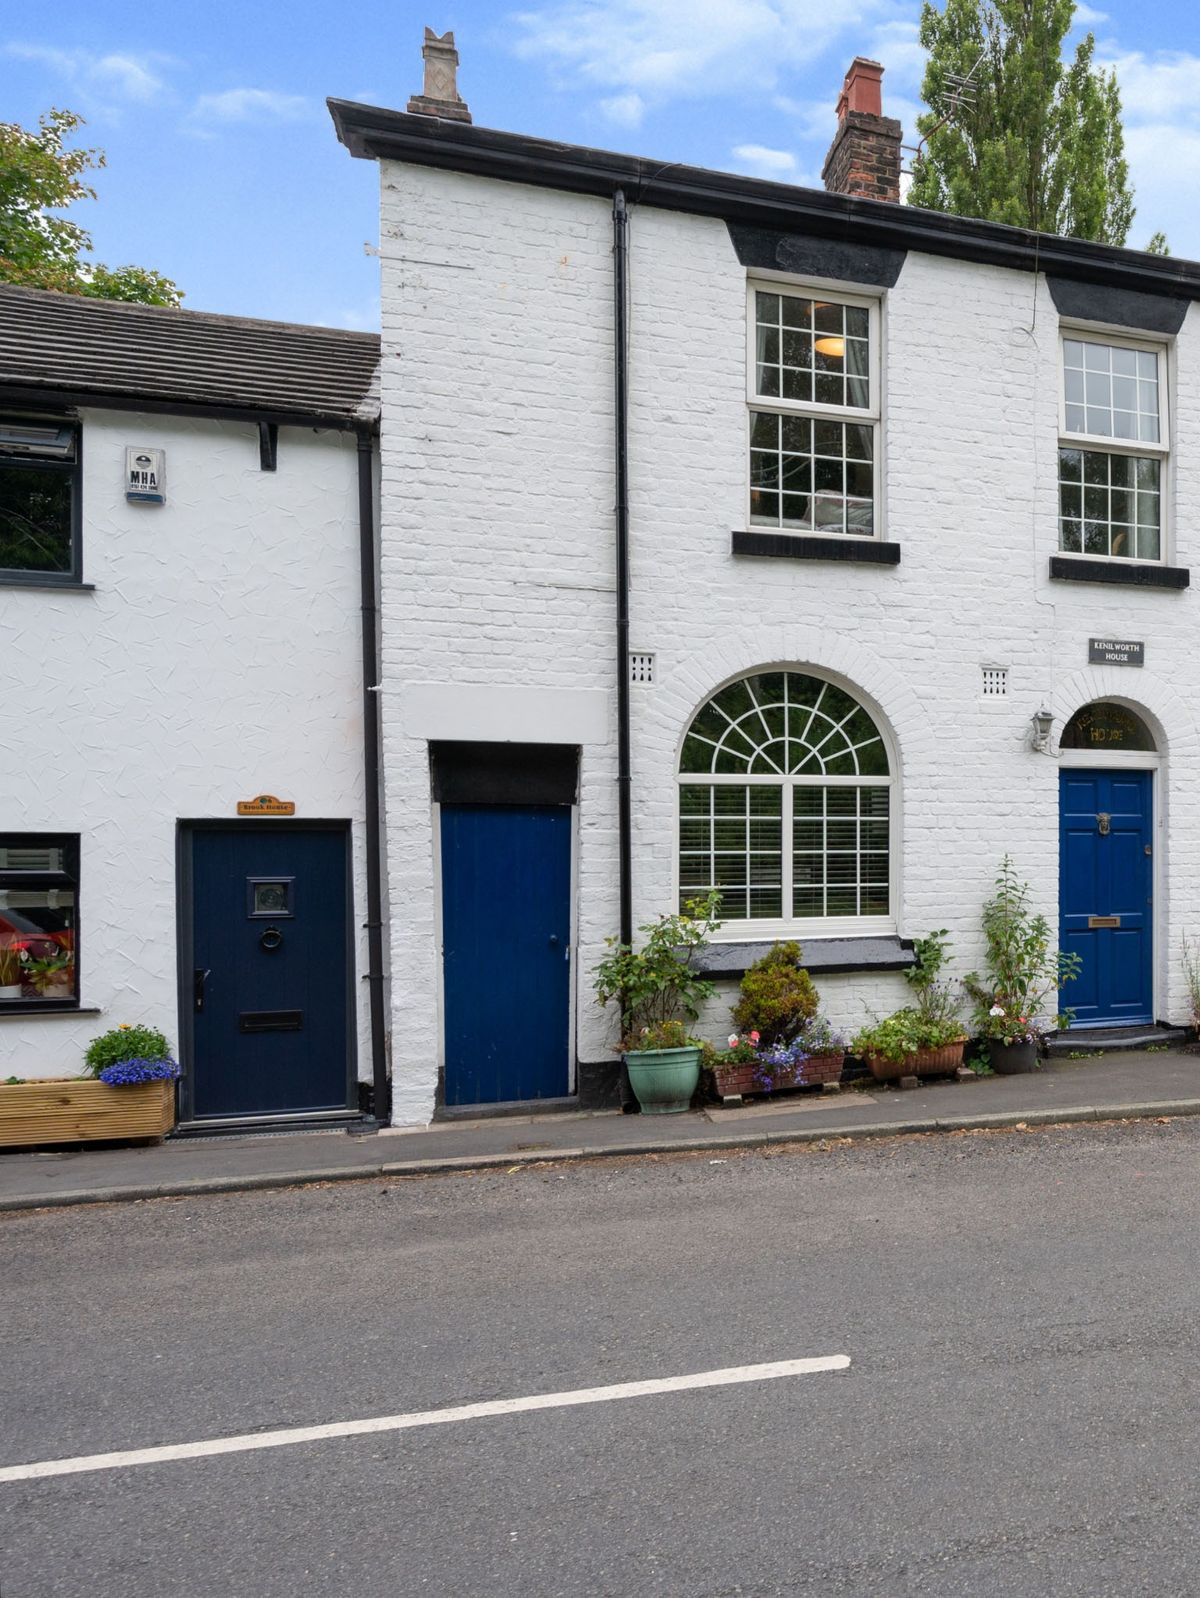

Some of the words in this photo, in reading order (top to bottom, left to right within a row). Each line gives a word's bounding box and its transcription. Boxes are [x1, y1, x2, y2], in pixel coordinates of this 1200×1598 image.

[130, 470, 156, 486] MHA
[1094, 641, 1140, 652] KENILWORTH
[1105, 652, 1129, 662] HOUSE
